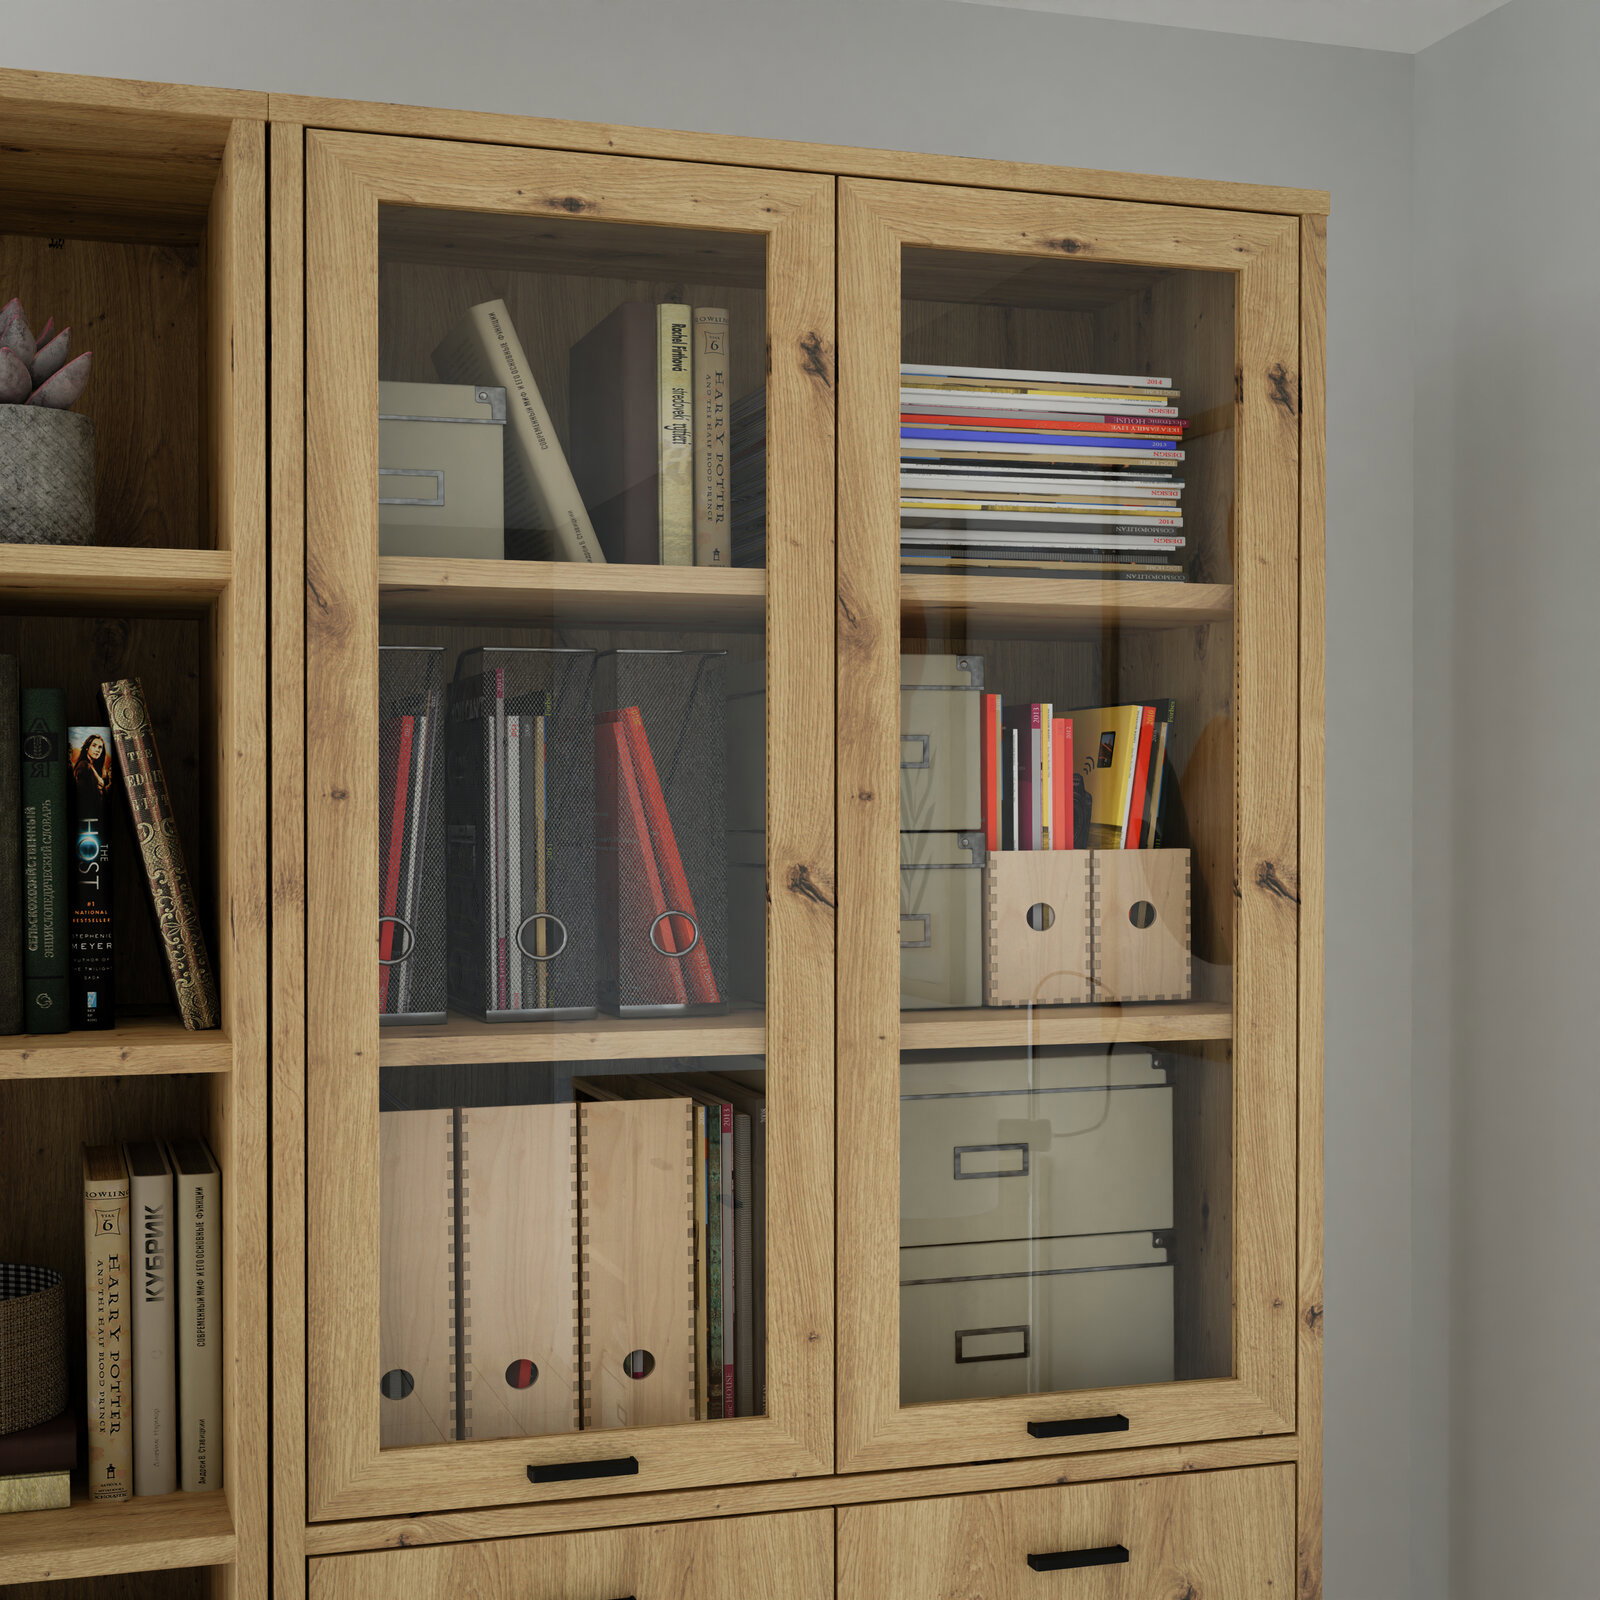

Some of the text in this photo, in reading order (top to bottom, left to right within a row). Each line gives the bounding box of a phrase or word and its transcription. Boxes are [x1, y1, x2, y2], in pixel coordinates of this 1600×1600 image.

[672, 323, 688, 345] Rachel
[710, 341, 719, 351] 6
[714, 371, 725, 524] HARRY POTTER
[1167, 700, 1176, 723] Forbes
[79, 818, 100, 890] HOST
[100, 844, 109, 862] THE
[71, 942, 113, 950] MEYER
[102, 1219, 113, 1231] 6
[144, 1204, 165, 1303] КУБРИК
[108, 1253, 121, 1436] HARRY POTTER
[98, 1352, 106, 1387] BLOOD
